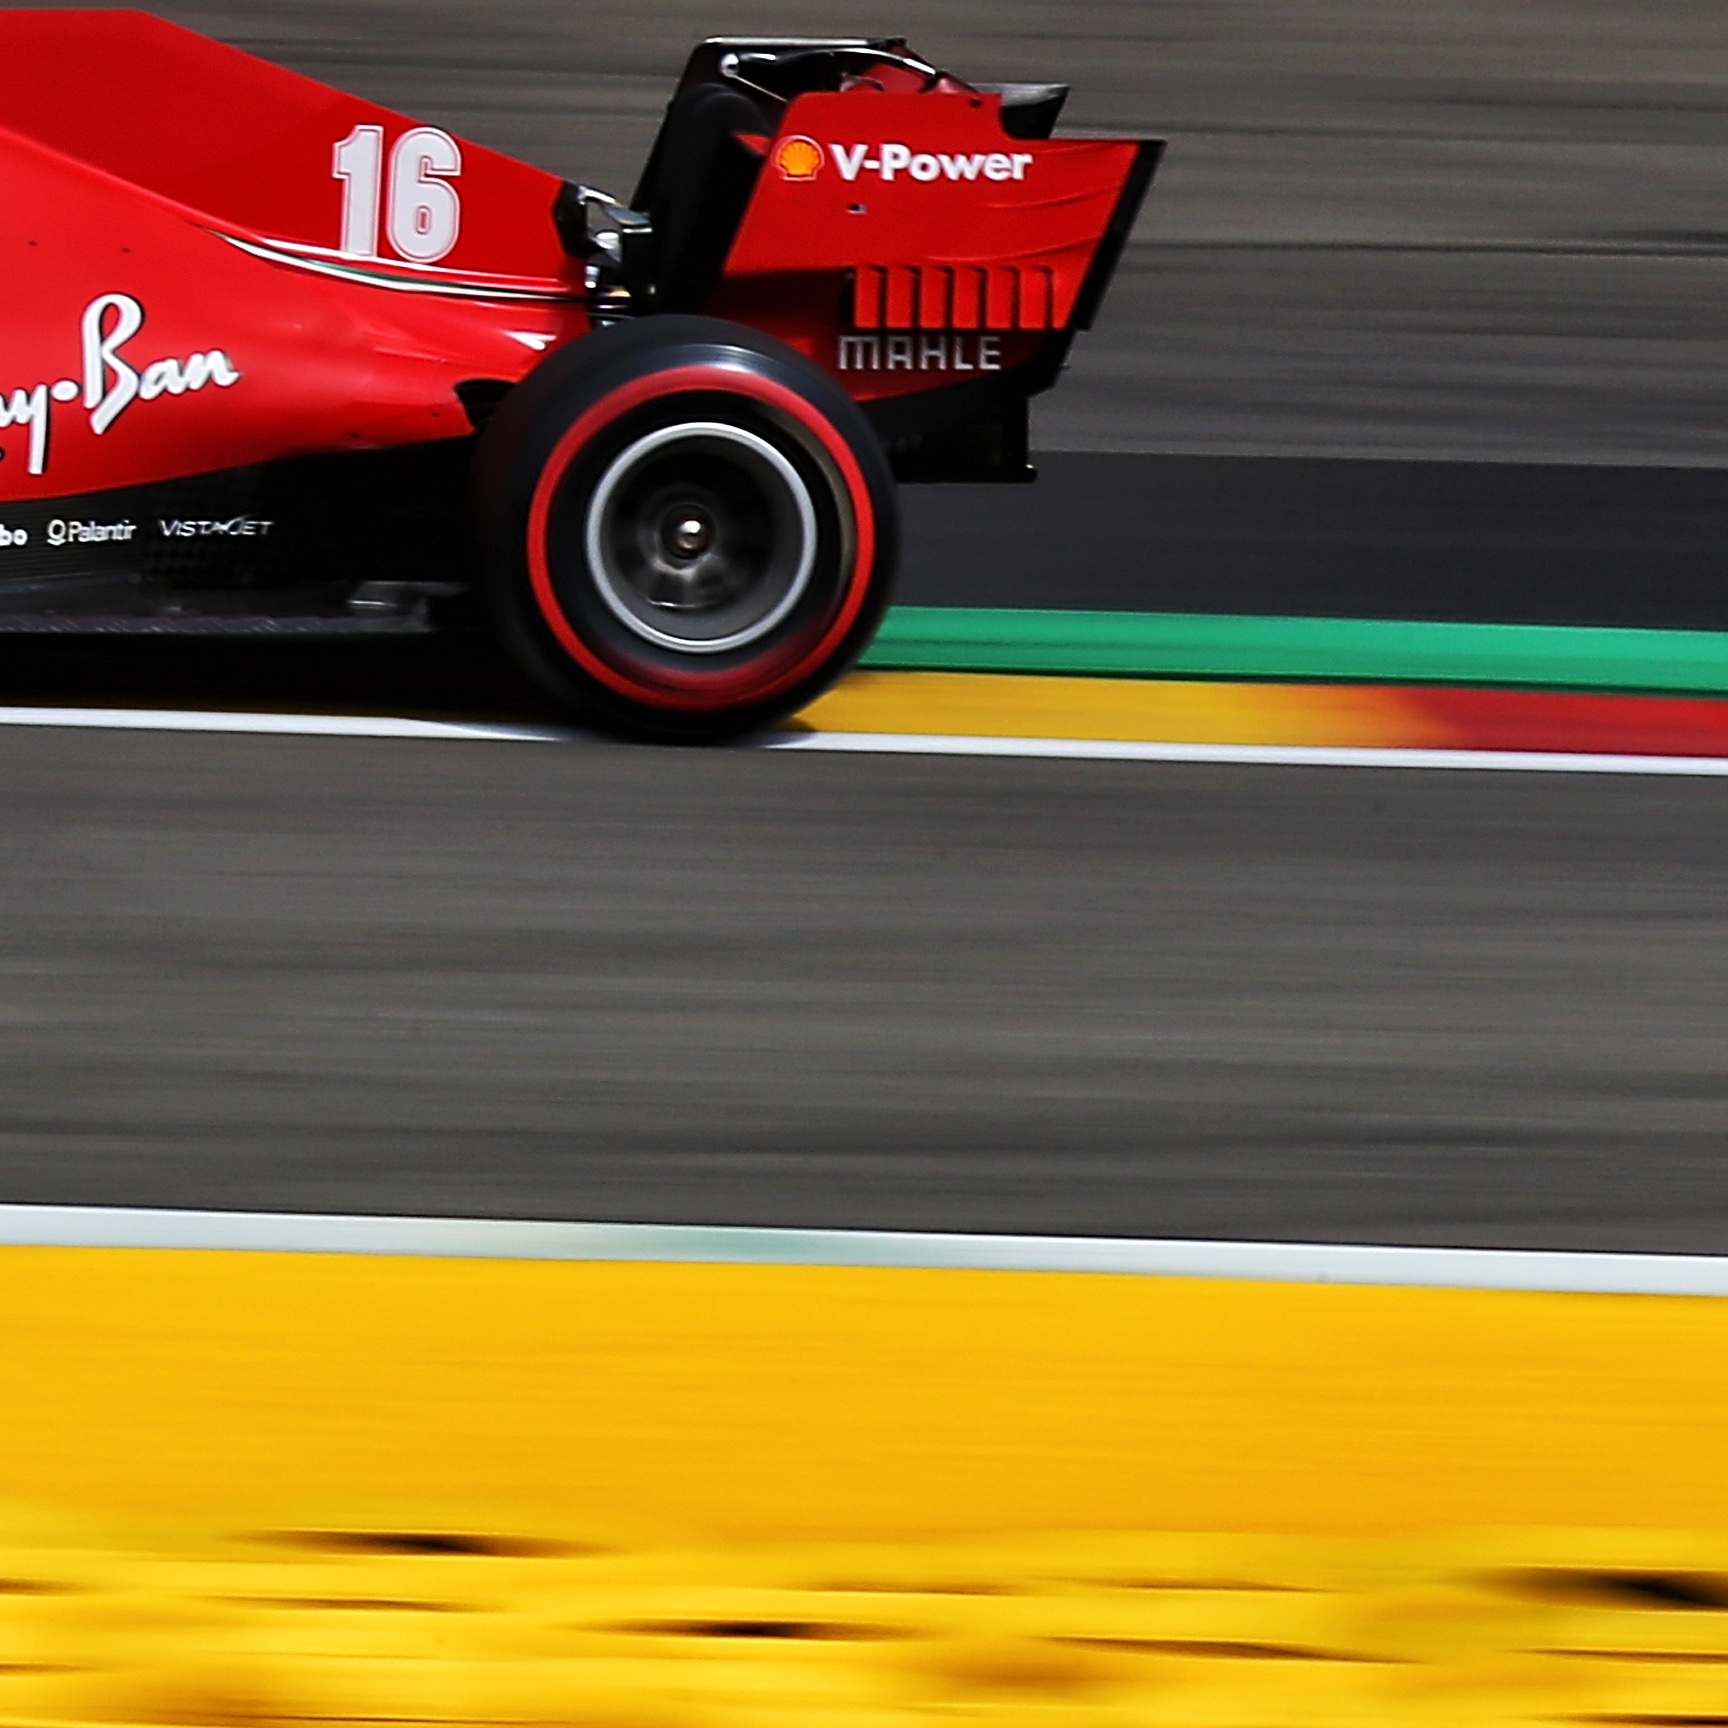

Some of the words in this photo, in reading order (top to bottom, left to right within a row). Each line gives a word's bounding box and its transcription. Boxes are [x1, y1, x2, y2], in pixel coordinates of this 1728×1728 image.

[829, 143, 1033, 181] V-Power
[332, 124, 462, 264] 16
[838, 335, 1001, 371] MAHLE
[67, 520, 138, 543] Palantir
